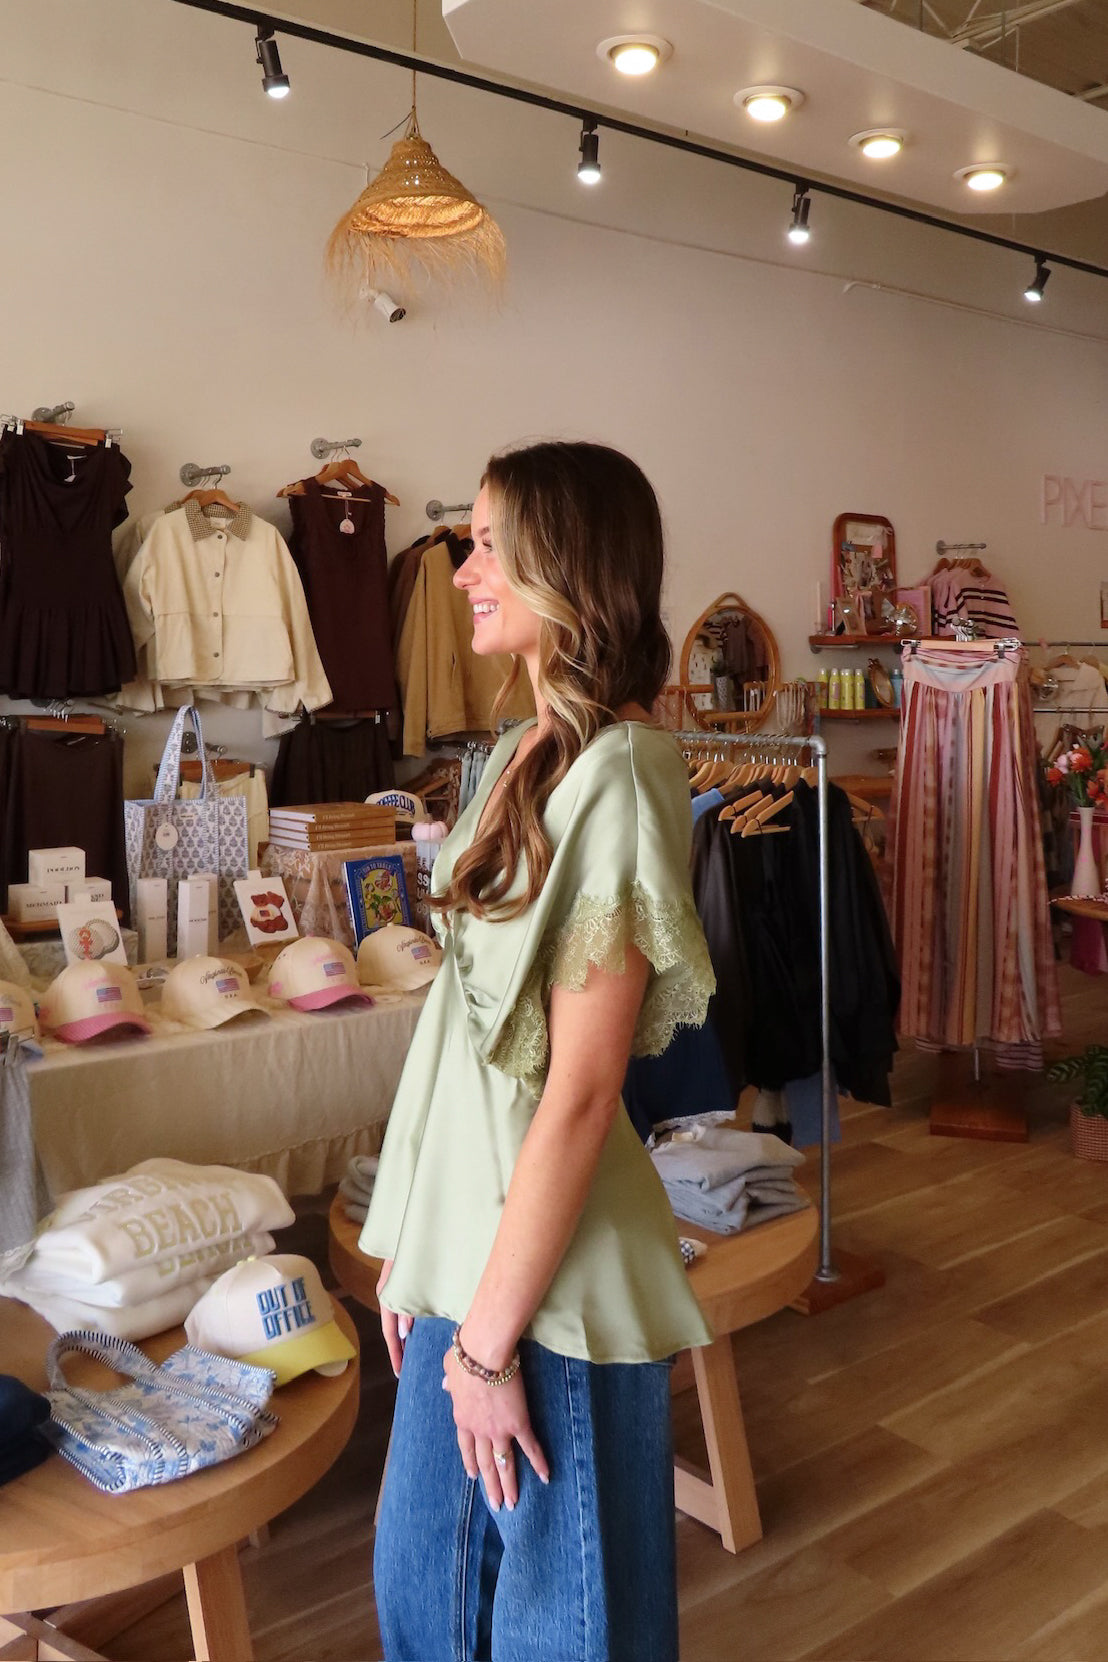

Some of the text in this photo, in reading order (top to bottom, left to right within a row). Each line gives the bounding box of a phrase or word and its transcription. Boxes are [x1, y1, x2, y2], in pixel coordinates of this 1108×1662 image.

[400, 795, 416, 816] CLUB
[119, 1191, 245, 1259] BEACH
[256, 1284, 287, 1316] OUT
